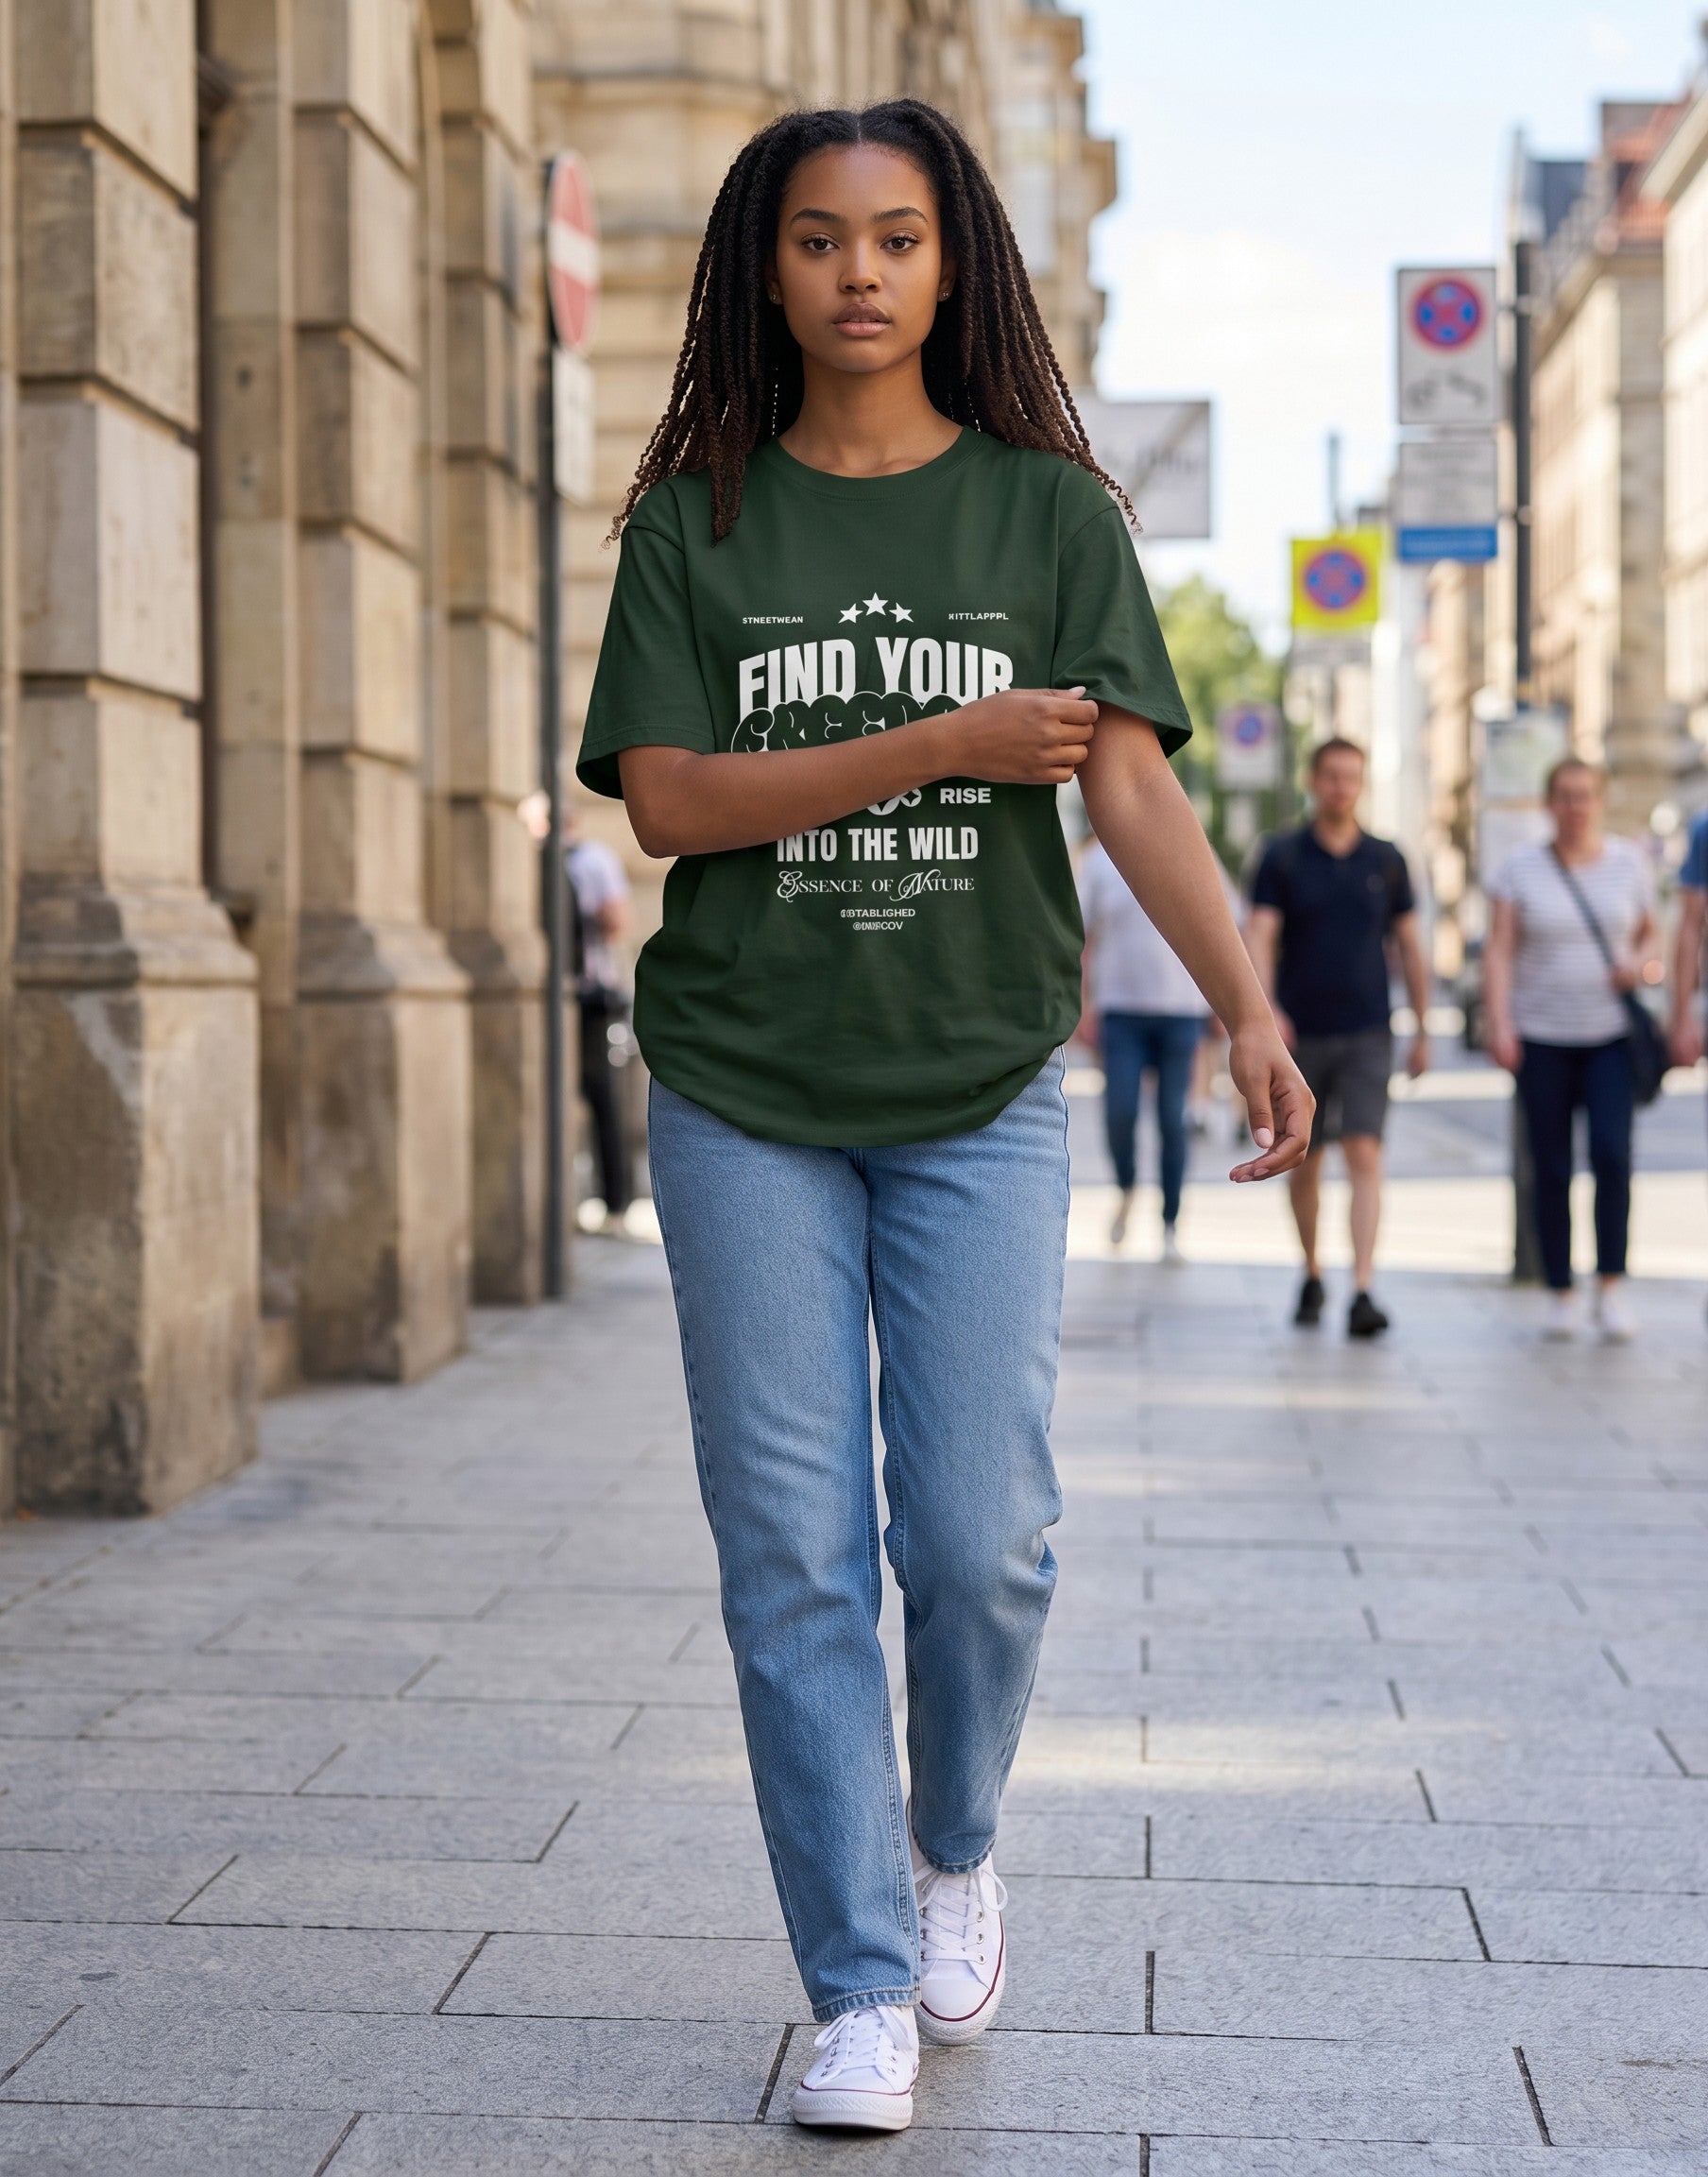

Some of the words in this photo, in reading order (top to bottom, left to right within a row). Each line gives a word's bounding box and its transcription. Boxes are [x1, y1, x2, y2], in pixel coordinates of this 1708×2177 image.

[739, 638, 857, 722] FIND
[876, 637, 1014, 706] YOUR
[940, 787, 992, 804] RISE
[777, 829, 836, 862] INTO
[847, 829, 898, 862] THE
[909, 826, 979, 861] WILD
[871, 879, 895, 892] OF
